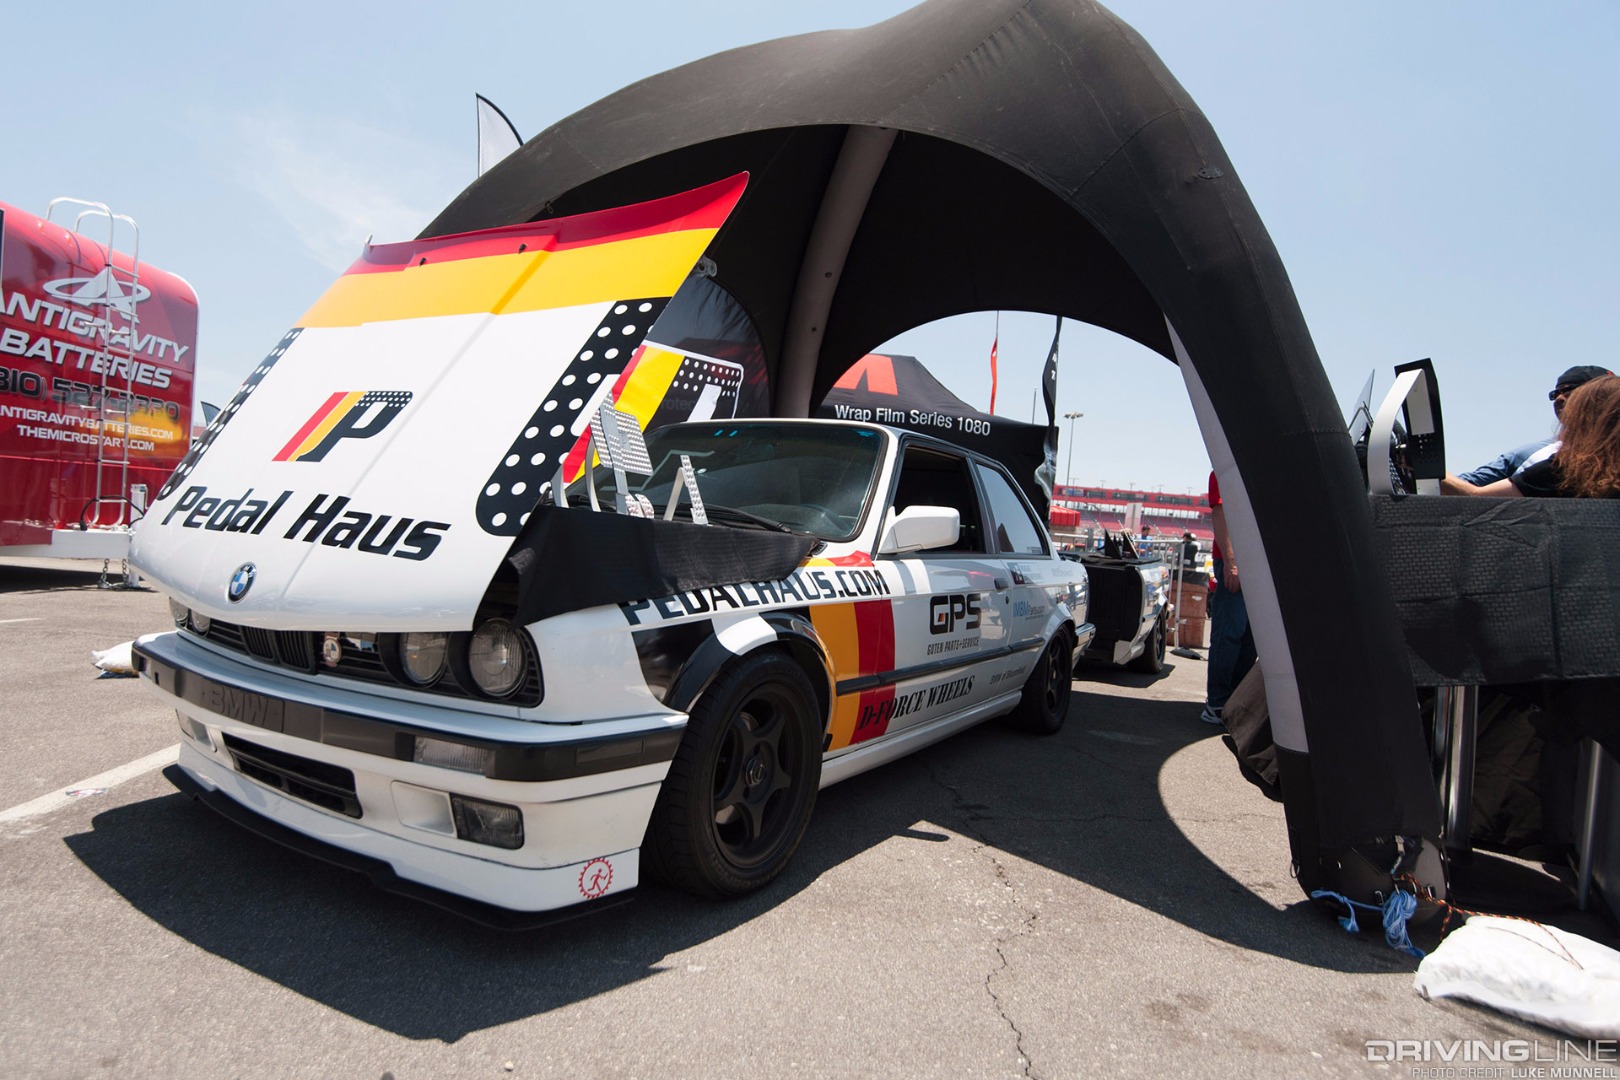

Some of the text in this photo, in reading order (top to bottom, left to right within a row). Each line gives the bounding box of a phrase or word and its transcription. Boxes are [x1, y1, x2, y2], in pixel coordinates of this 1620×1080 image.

[0, 286, 188, 363] NTIGRAVITY
[0, 328, 172, 389] BATTERIES
[835, 404, 991, 436] Wrap Film Series 1080
[160, 486, 452, 561] Pedal Haus
[617, 570, 890, 626] PEDALHAUS.COM
[929, 593, 981, 635] GPS
[858, 675, 975, 730] D-FORCE WHEELS
